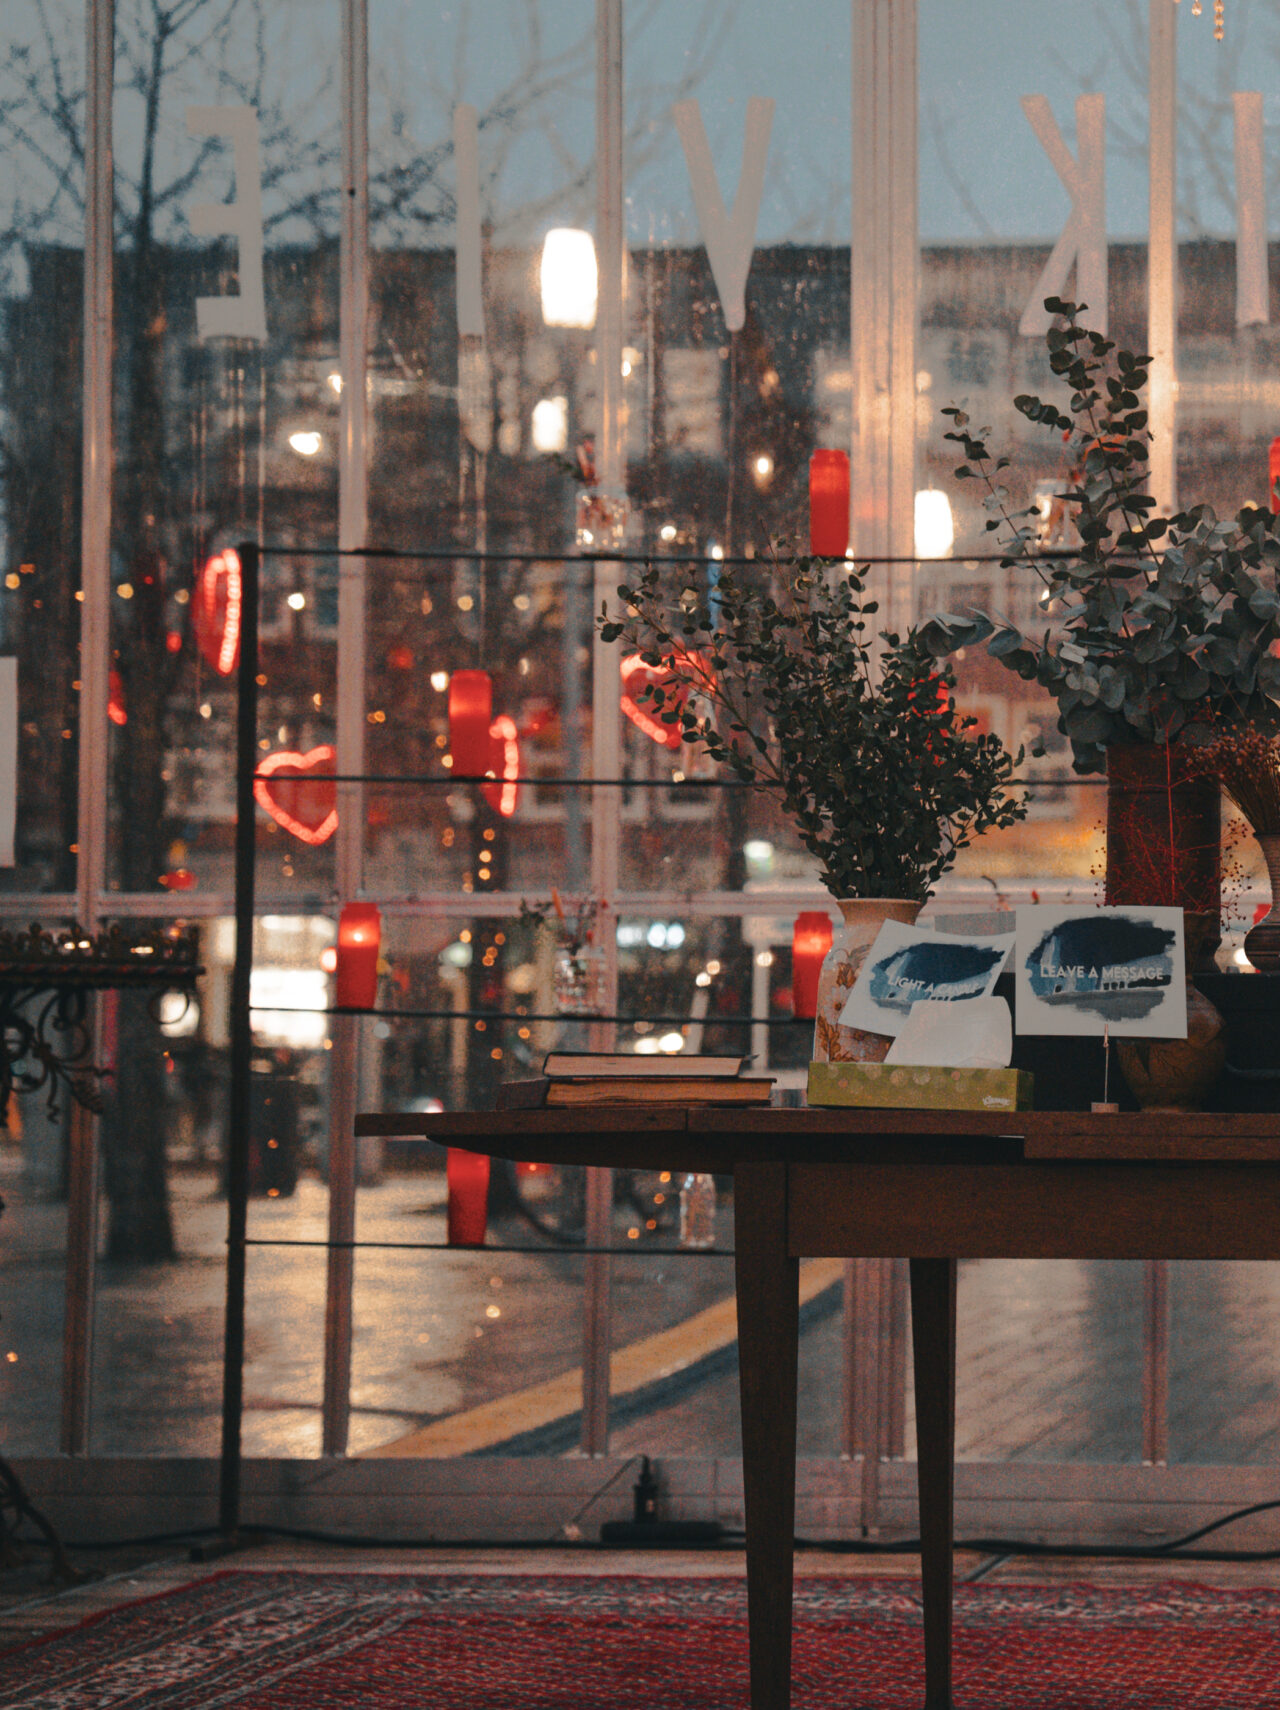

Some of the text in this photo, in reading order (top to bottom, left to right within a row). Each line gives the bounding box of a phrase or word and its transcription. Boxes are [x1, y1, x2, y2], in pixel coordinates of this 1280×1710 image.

[1040, 965, 1164, 980] LEAVE A MESSAGE
[887, 976, 926, 992] LIGHT
[924, 981, 935, 993] A
